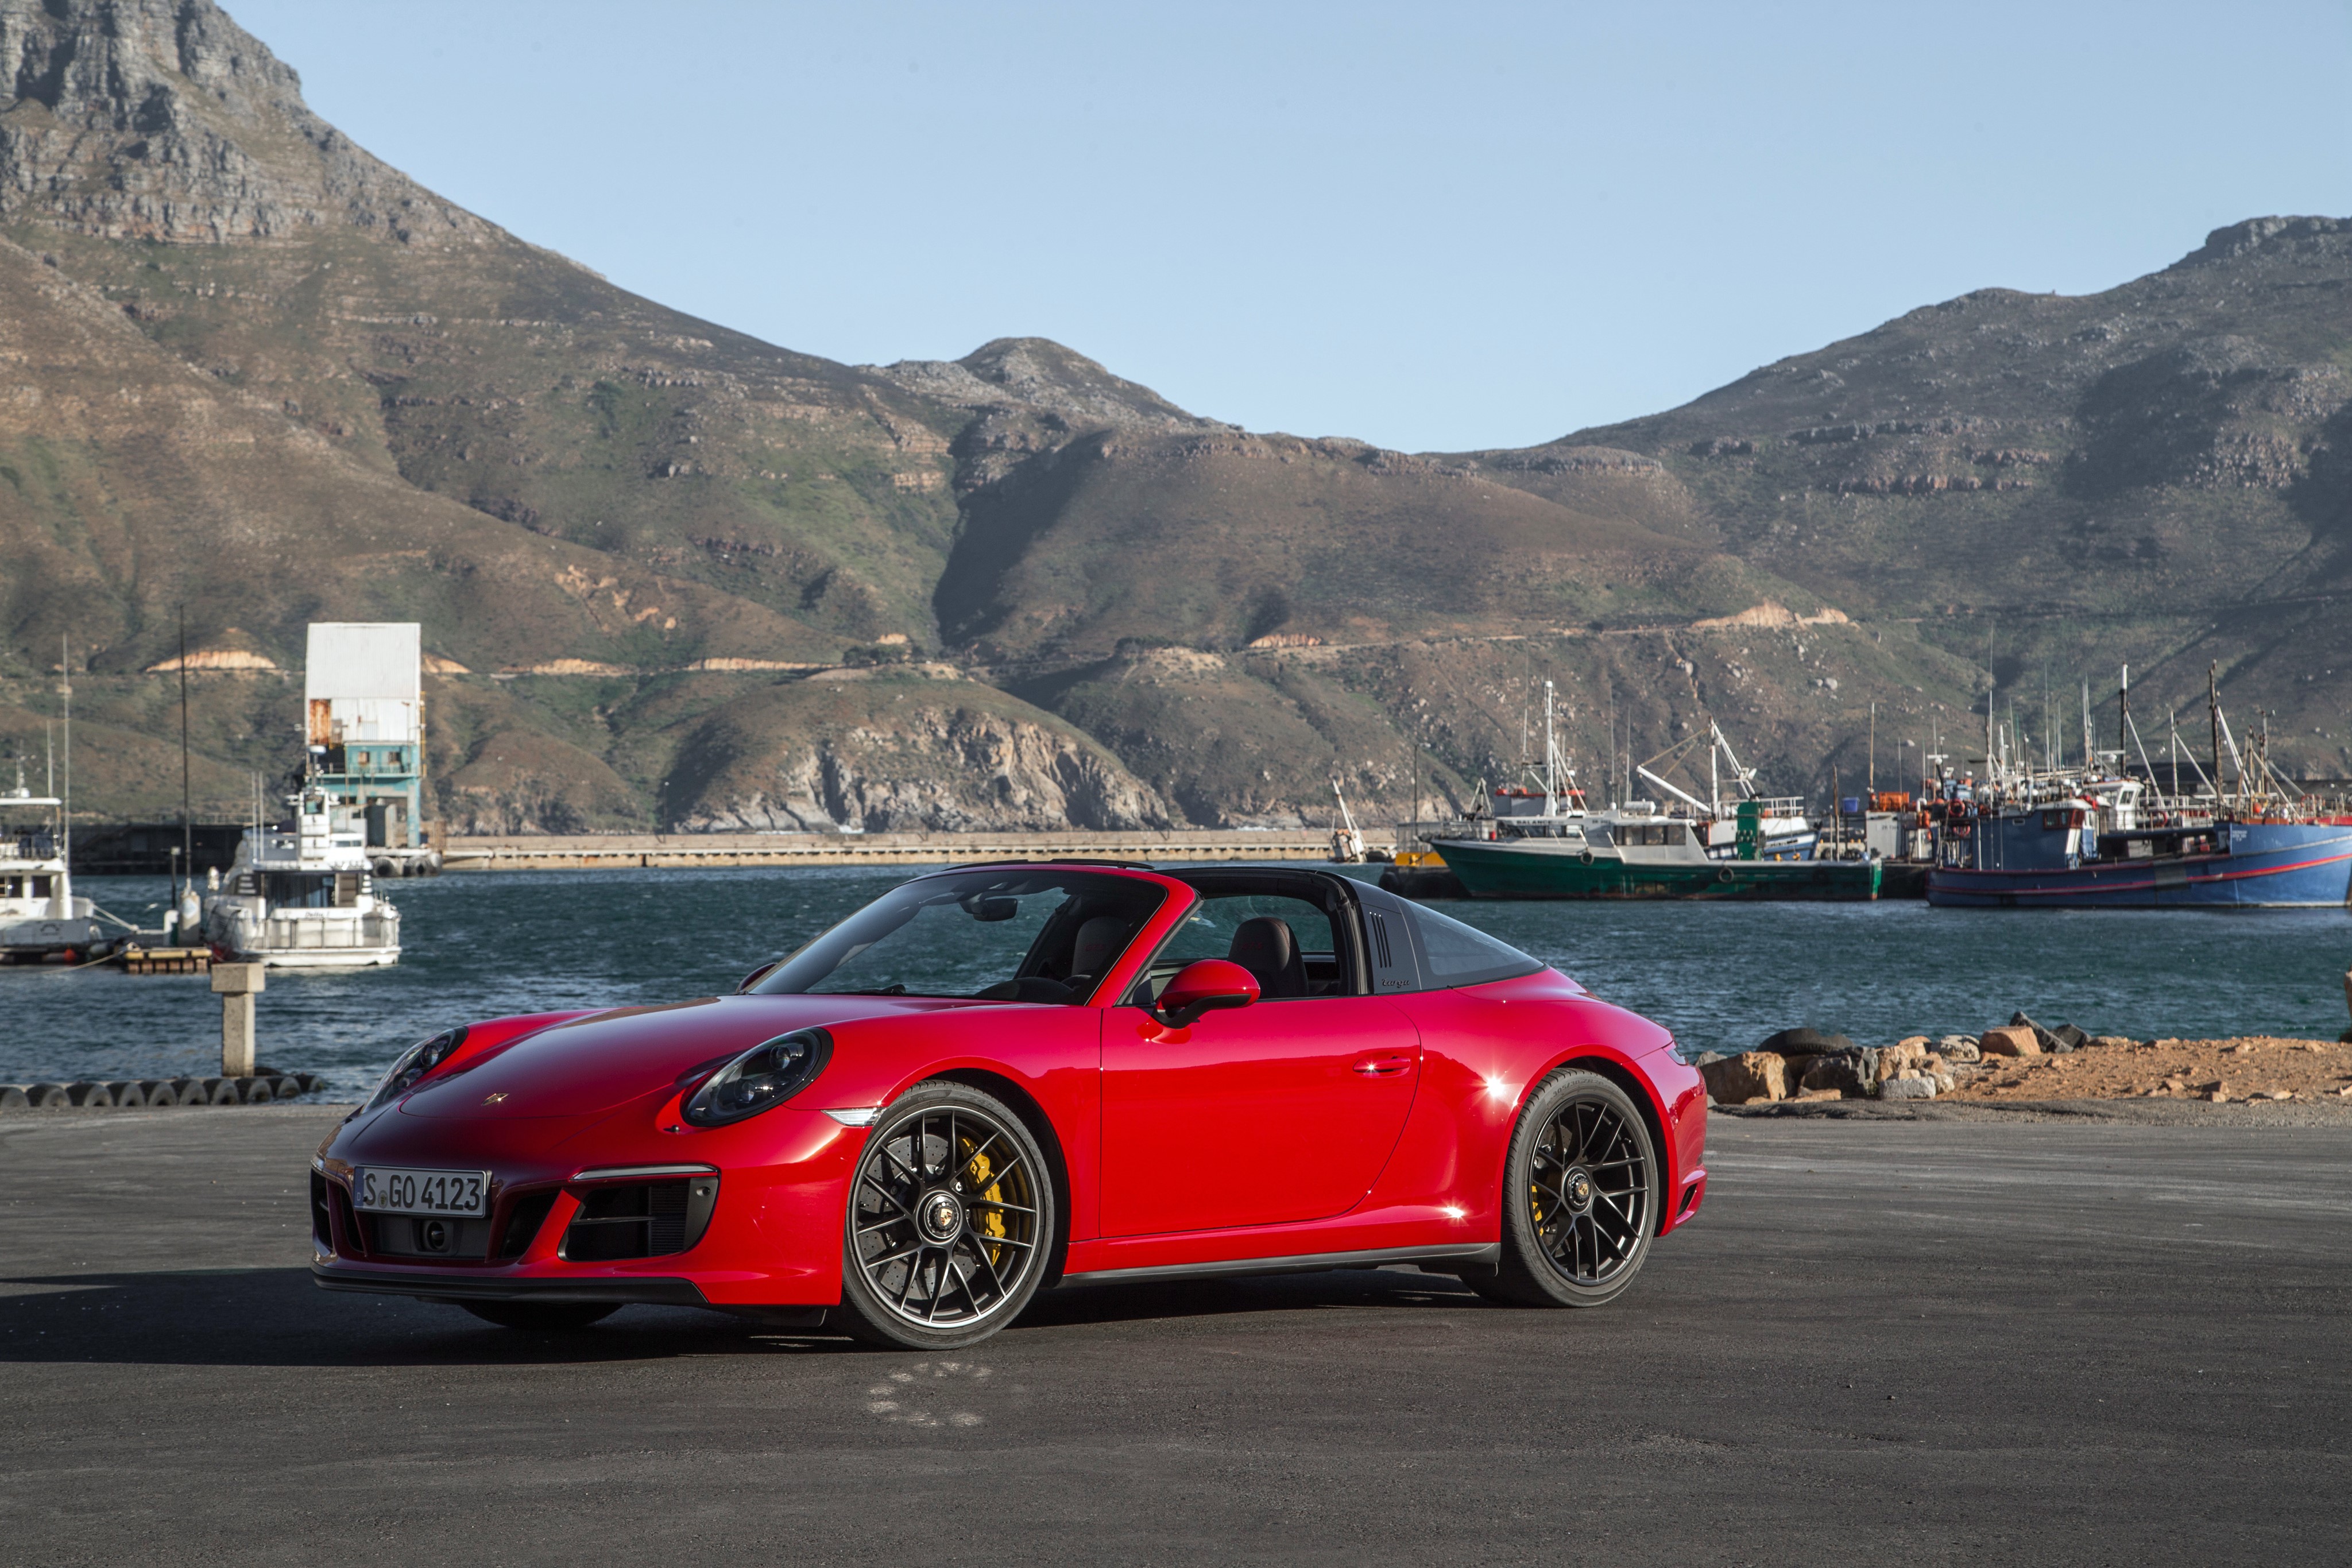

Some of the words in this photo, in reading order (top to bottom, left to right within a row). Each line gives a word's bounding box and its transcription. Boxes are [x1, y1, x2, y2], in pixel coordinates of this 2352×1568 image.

[1381, 977, 1411, 988] Targa
[357, 1192, 361, 1201] D
[365, 1173, 376, 1206] S
[389, 1175, 416, 1209] GO
[421, 1177, 480, 1211] 4123
